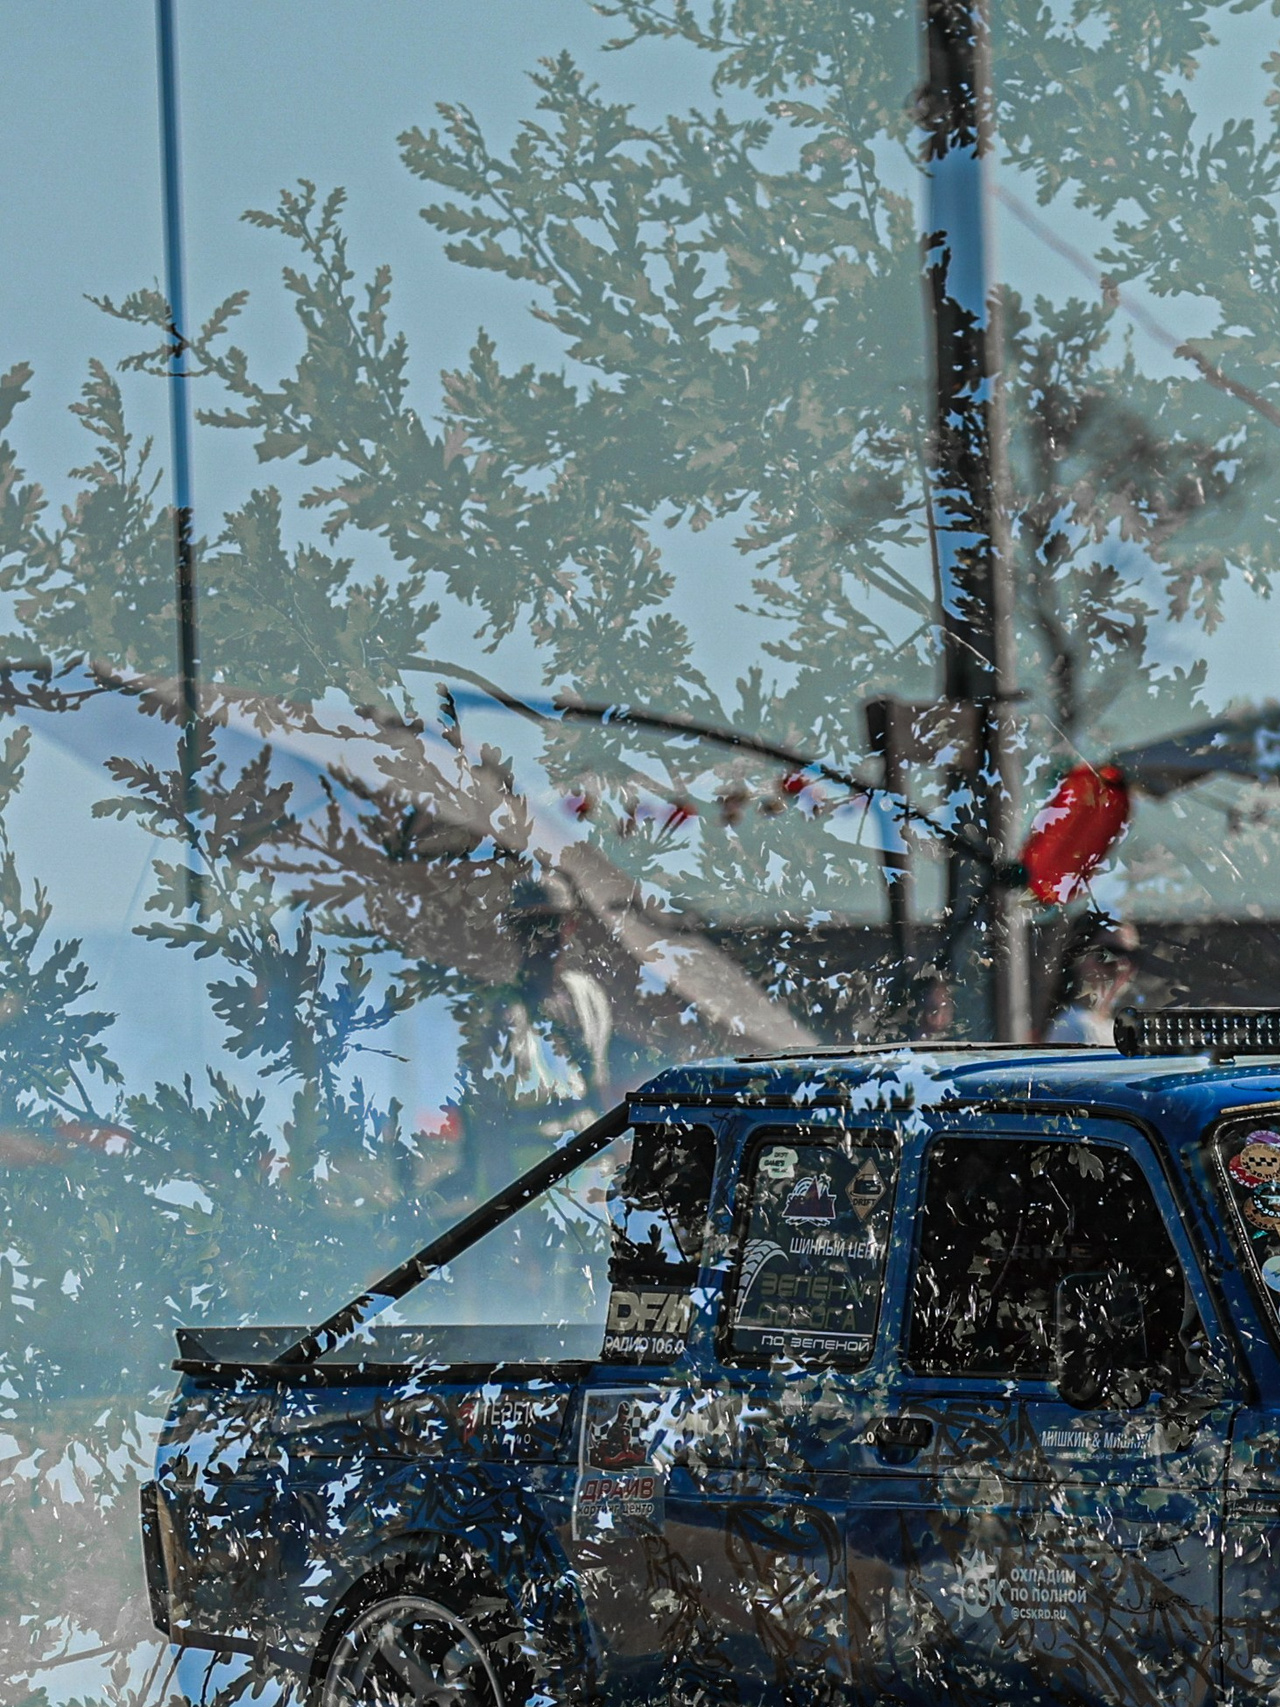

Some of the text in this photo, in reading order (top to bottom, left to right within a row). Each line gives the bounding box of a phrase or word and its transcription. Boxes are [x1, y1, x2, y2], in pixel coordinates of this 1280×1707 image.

[607, 1290, 693, 1334] DFM
[604, 1335, 685, 1355] РАДИО 106.0
[761, 1335, 870, 1352] ПО ЗЕЛЕНОЙ
[1041, 1430, 1090, 1448] МИШКИН
[1010, 1569, 1077, 1585] ОХЛАДИМ
[1010, 1586, 1088, 1604] ПО ПОЛНОЙ
[1010, 1607, 1067, 1620] @CSKRD.RU
